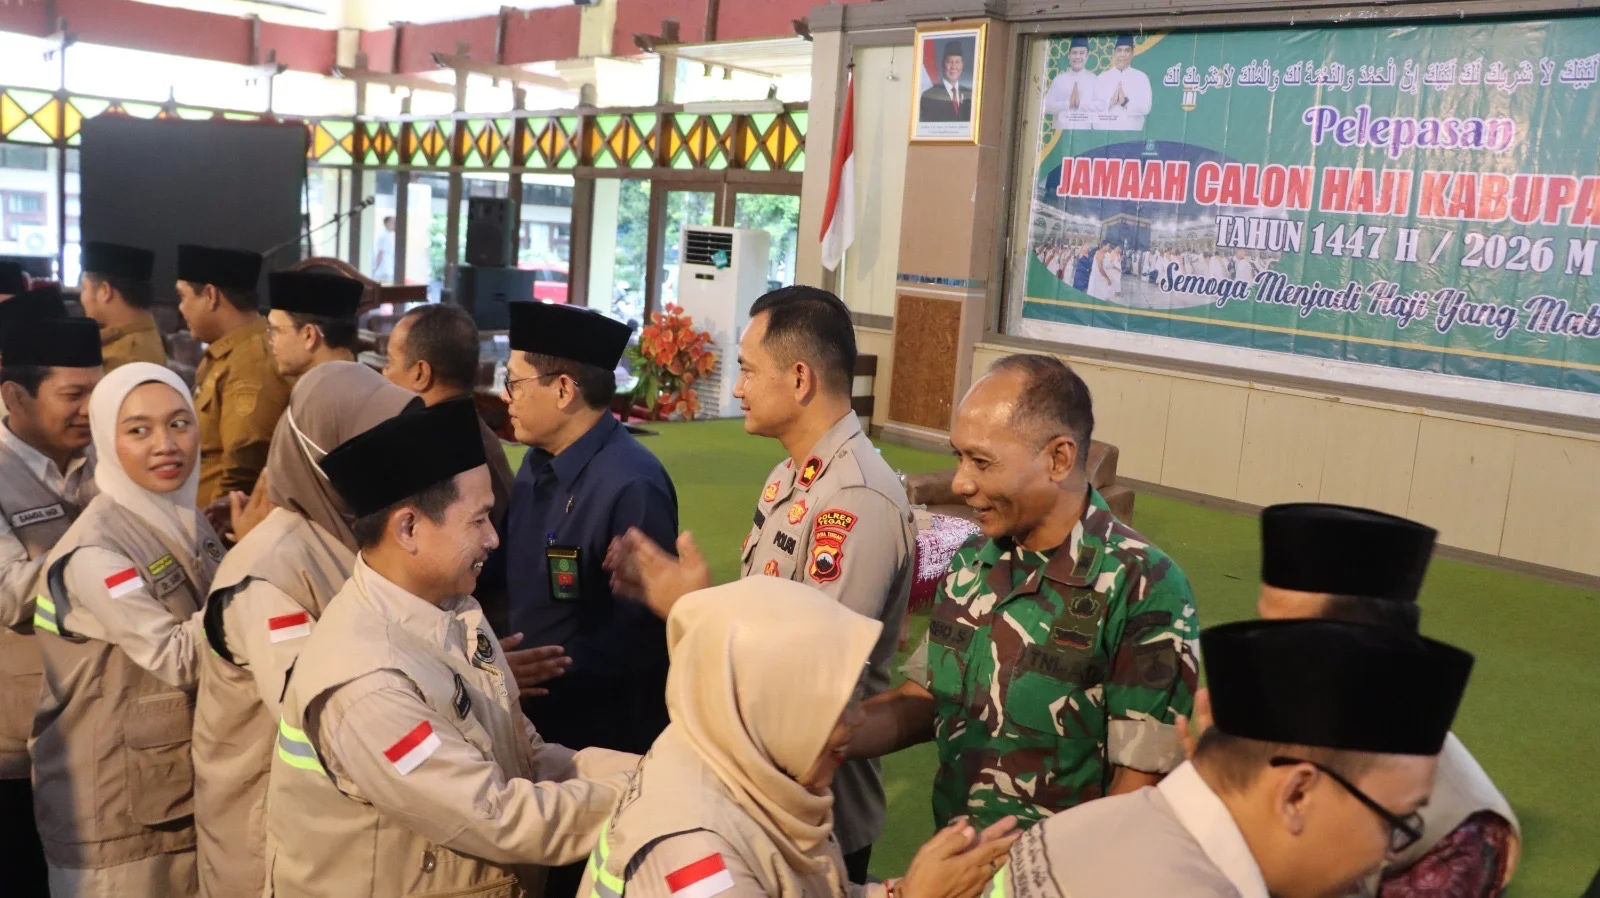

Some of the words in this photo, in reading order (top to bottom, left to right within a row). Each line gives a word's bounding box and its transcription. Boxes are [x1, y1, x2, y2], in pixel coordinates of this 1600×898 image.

[1304, 105, 1513, 158] Pelepasan
[1056, 157, 1189, 203] JAMAAH
[1195, 162, 1314, 209] CALON
[1320, 167, 1413, 217] HAJI
[1417, 171, 1600, 226] KABUPA
[1216, 215, 1304, 253] TAHUN
[1311, 222, 1388, 261] 1447
[1394, 227, 1421, 263] H
[1428, 230, 1455, 265] /
[1460, 232, 1554, 273] 2026
[1564, 238, 1599, 276] M
[1160, 262, 1248, 308] Semoga
[1254, 270, 1362, 318] Menjadi
[1367, 280, 1430, 329] Haji
[1432, 288, 1519, 340] Yang
[818, 512, 852, 524] POLRES
[819, 518, 847, 527] TEGAL
